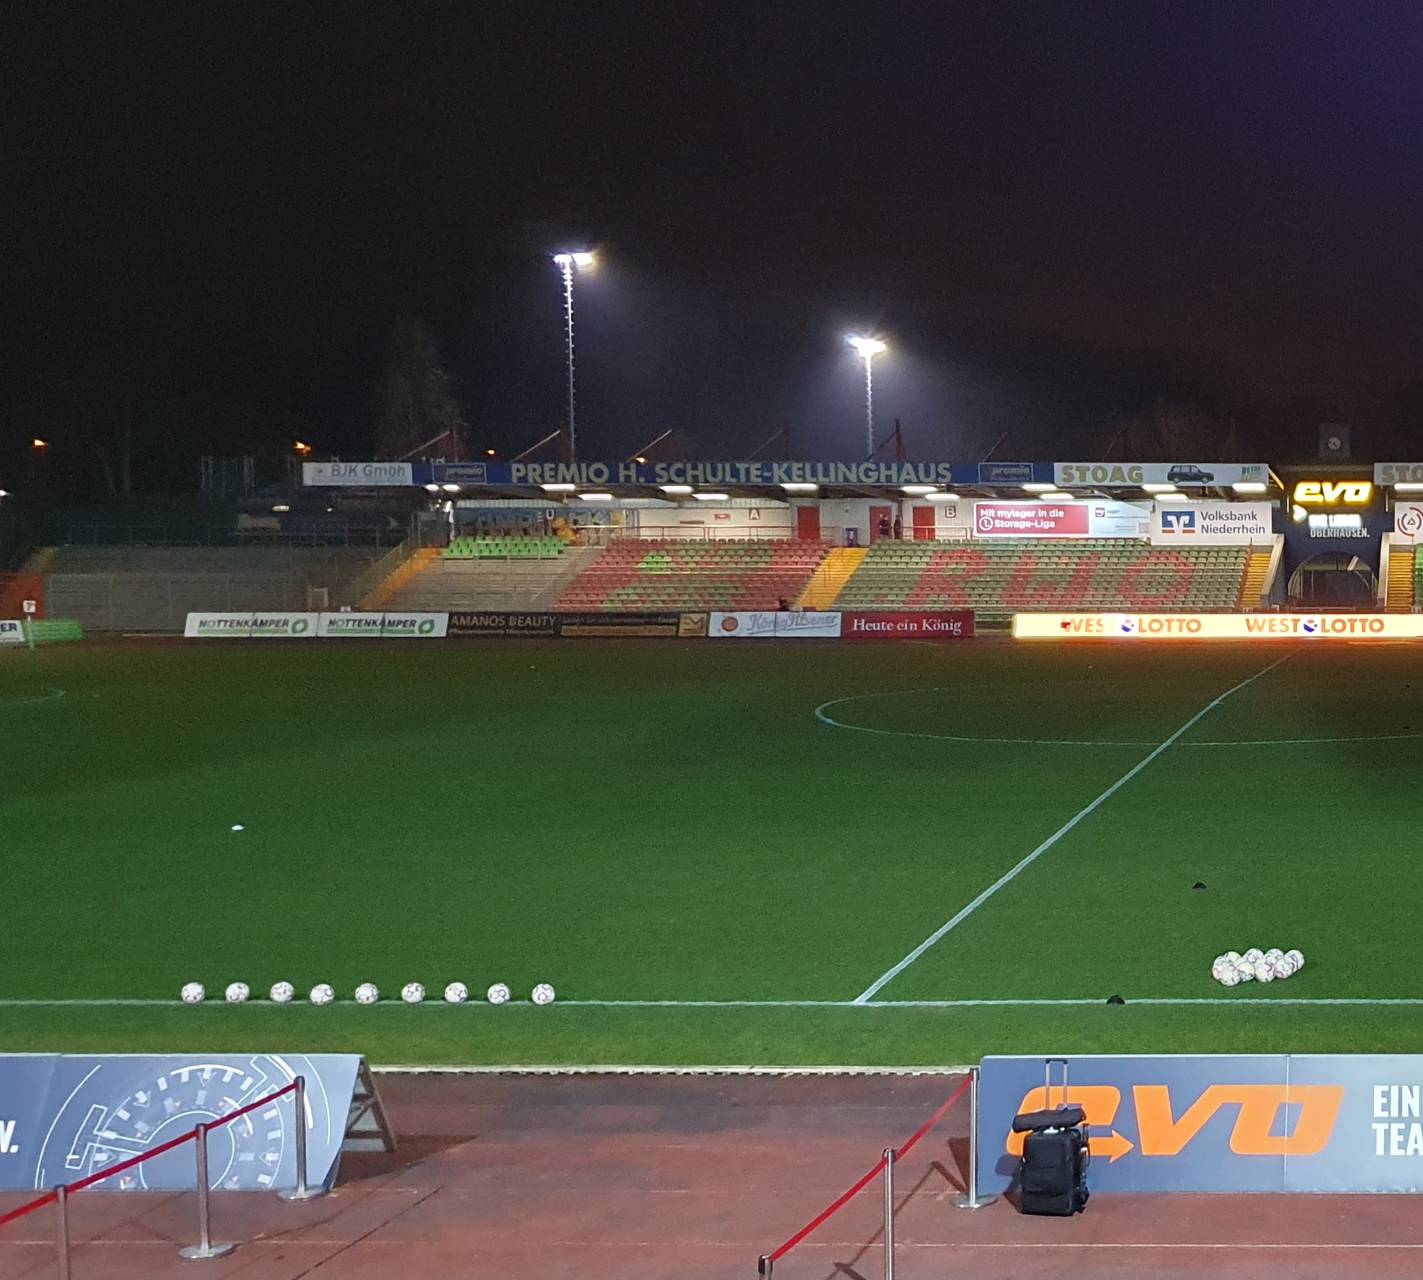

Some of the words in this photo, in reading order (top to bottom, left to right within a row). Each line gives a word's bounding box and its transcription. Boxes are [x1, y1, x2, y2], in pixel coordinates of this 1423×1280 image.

[331, 464, 358, 477] BJK
[511, 463, 609, 484] PREMIO
[619, 463, 645, 483] H.
[655, 463, 952, 484] SCHULTE-KELLINGHAUS
[1061, 465, 1144, 483] STOAG
[1293, 481, 1372, 502] evo
[749, 508, 760, 520] A
[946, 507, 955, 517] B
[980, 508, 995, 517] Mit
[997, 509, 1036, 518] mylager
[1038, 508, 1047, 517] in
[1049, 508, 1064, 517] die
[1200, 511, 1258, 521] Volksbank
[994, 519, 1056, 529] Storage-Liga
[1200, 523, 1266, 534] Niederrhein
[450, 615, 505, 626] AMANOS
[509, 615, 557, 626] BEAUTY
[853, 619, 894, 631] Heute
[897, 619, 918, 631] ein
[922, 618, 962, 636] König
[1139, 618, 1202, 633] LOTTO
[1245, 618, 1301, 633] WEST
[1321, 618, 1385, 633] LOTTO
[1373, 1085, 1420, 1118] EIN
